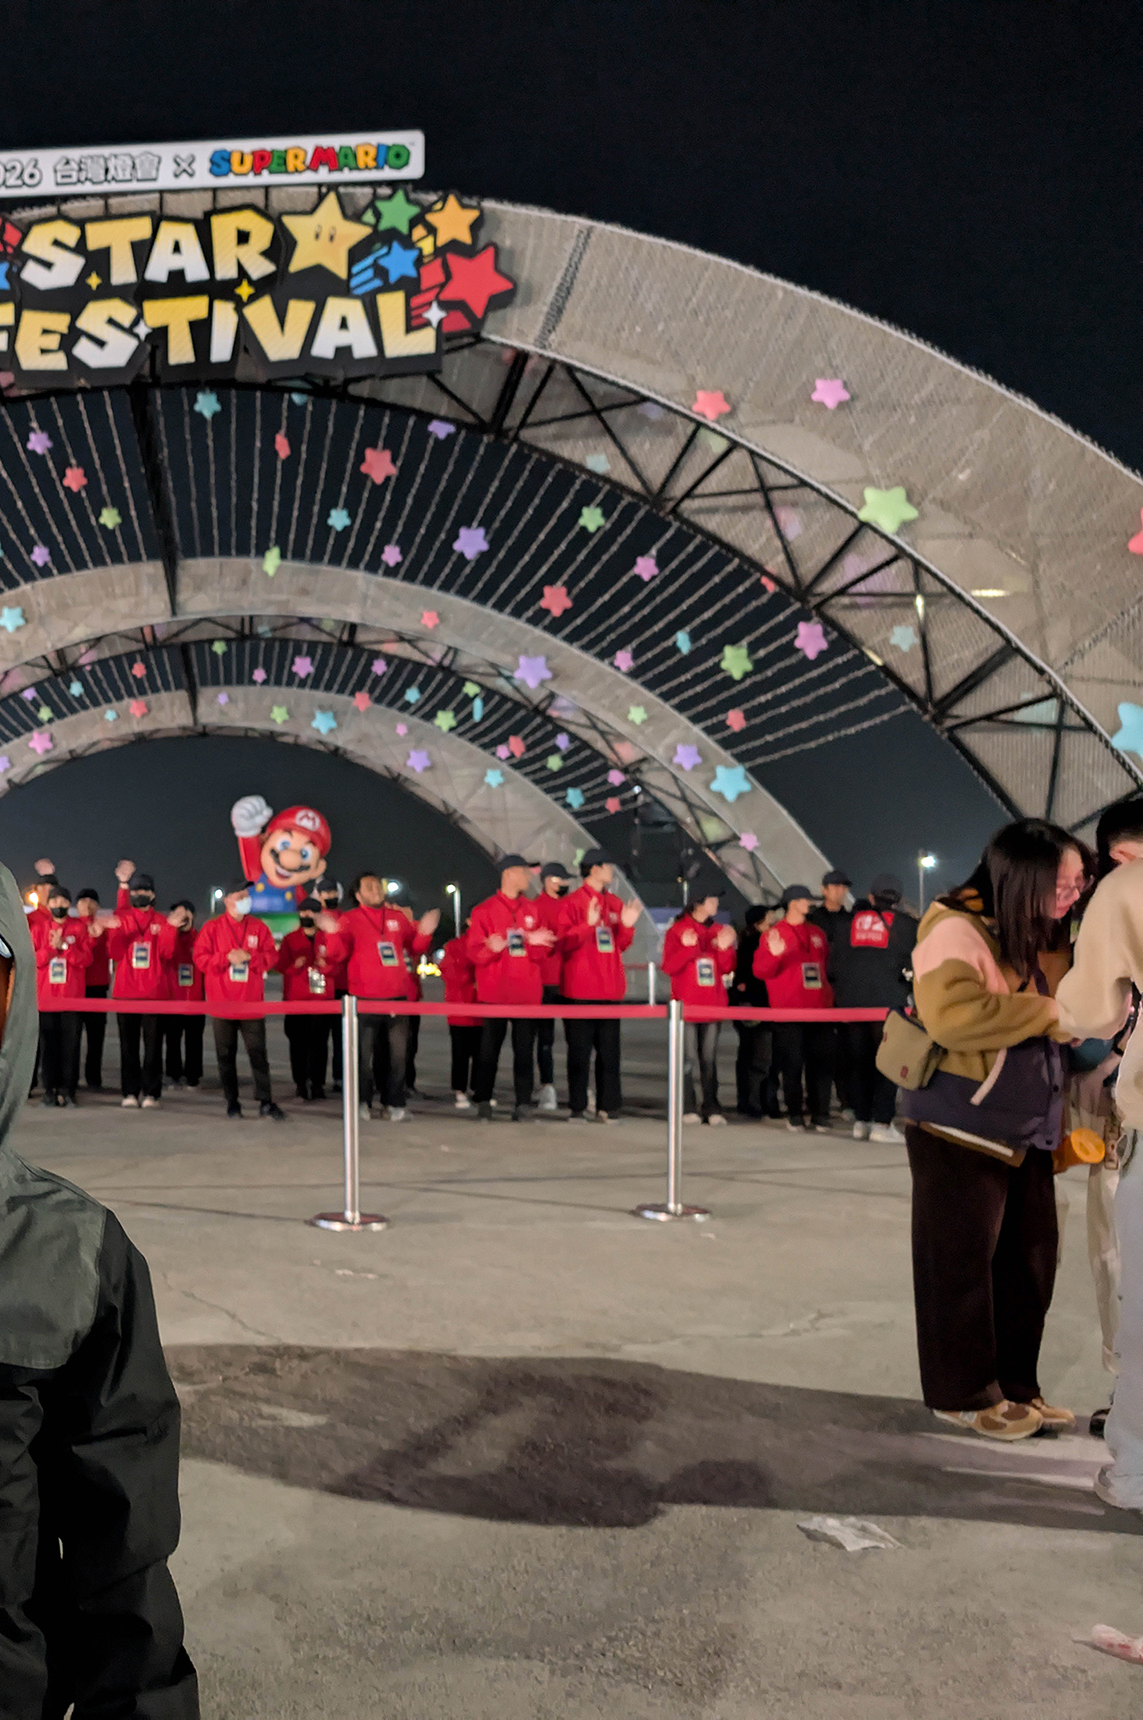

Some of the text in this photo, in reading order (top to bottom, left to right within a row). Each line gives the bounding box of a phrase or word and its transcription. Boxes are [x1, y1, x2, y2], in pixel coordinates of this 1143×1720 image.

[209, 146, 307, 176] SUPER
[308, 142, 410, 171] MARIO
[20, 209, 277, 290] STAR
